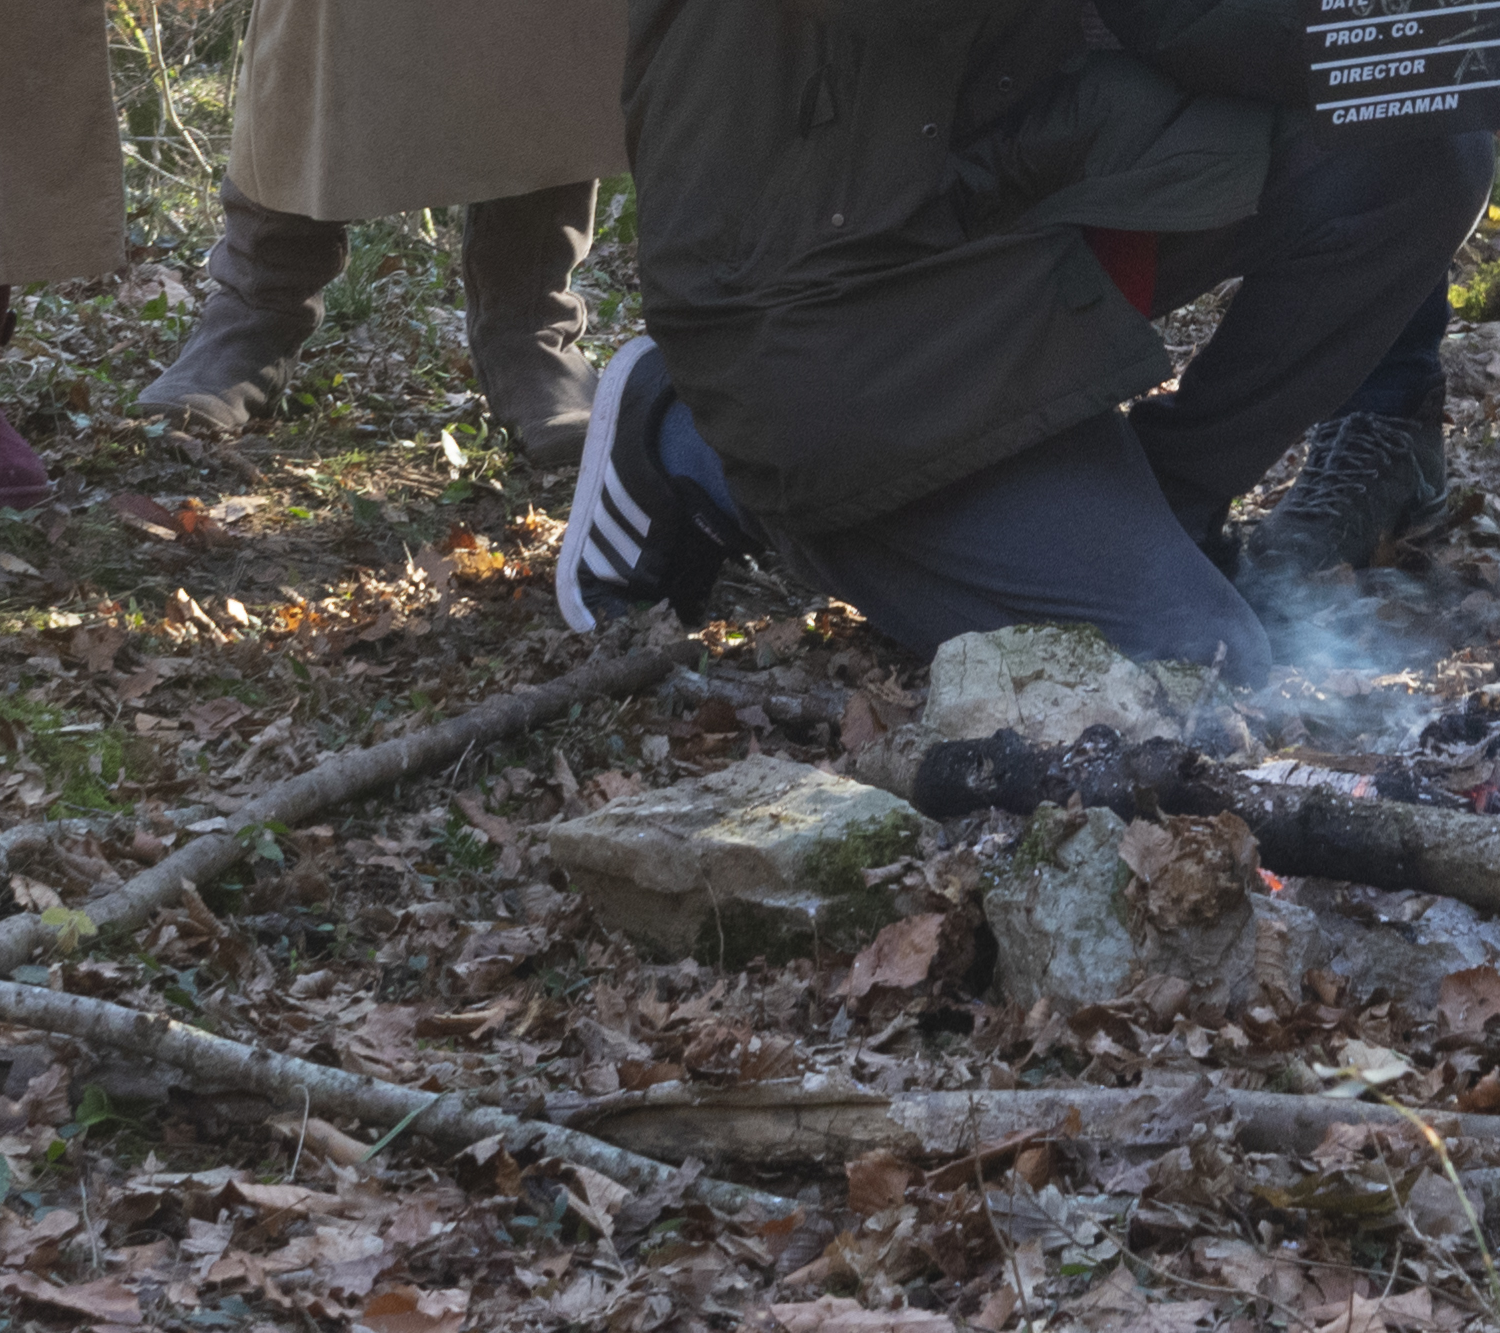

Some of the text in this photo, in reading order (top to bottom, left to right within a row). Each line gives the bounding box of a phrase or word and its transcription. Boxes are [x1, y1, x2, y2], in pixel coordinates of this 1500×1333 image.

[1325, 21, 1424, 48] PROD. CO.
[1329, 59, 1426, 86] DIRECTOR
[1332, 93, 1459, 125] CAMERAMAN
